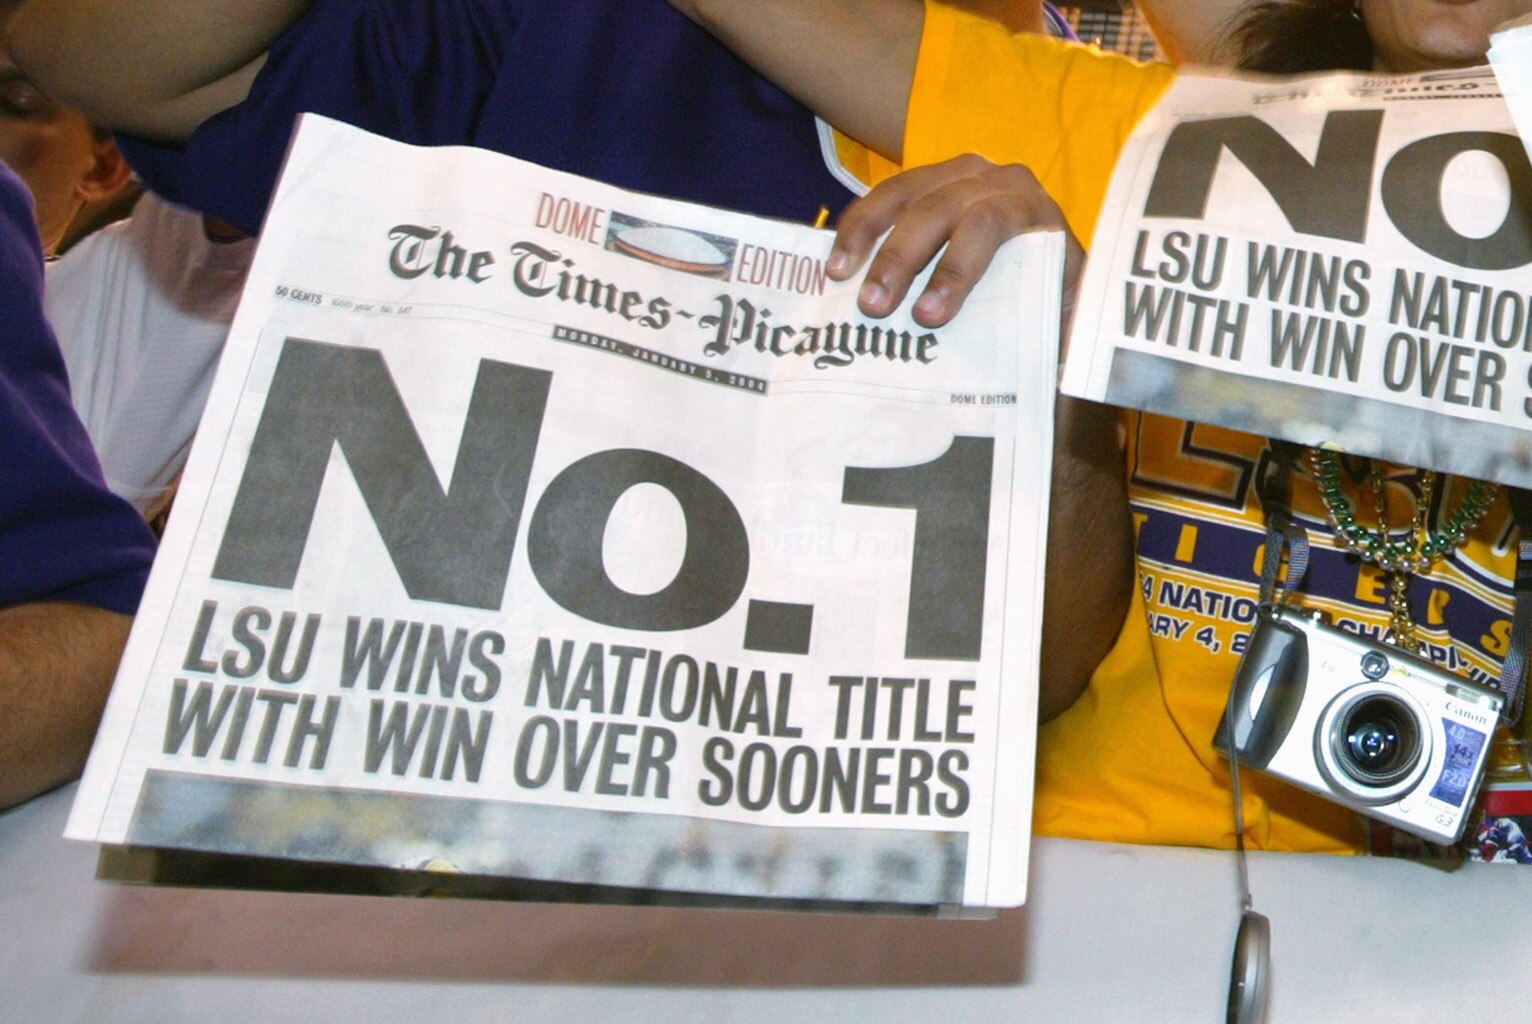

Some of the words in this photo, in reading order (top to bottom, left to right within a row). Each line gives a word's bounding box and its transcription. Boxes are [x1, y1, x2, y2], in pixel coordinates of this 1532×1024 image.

[534, 191, 606, 246] DOME
[737, 243, 829, 297] EDITION
[1129, 229, 1229, 294] LSU
[1246, 241, 1372, 320] WINS
[290, 287, 323, 306] CENTS
[387, 224, 496, 284] The
[510, 241, 940, 370] Times-Picayune
[556, 327, 624, 355] MONDAY,
[633, 346, 698, 376] JANUARY
[728, 376, 767, 393] 2004
[1122, 280, 1250, 363] WITH
[1269, 309, 1367, 384] WIN
[1383, 330, 1508, 414] OVER
[950, 393, 977, 405] DOME
[980, 393, 1018, 406] EDITION
[1158, 579, 1262, 625] NATIO
[184, 600, 322, 682] LSU
[341, 615, 506, 702] WINS
[527, 637, 803, 740] NATIONAL
[828, 674, 978, 743] TITLE
[1194, 624, 1223, 653] 4,
[1444, 700, 1487, 726] Canon
[161, 678, 342, 770] WITH
[365, 700, 498, 784] WIN
[512, 714, 674, 801] OVER
[696, 732, 971, 819] SOONERS
[1435, 813, 1455, 828] G3
